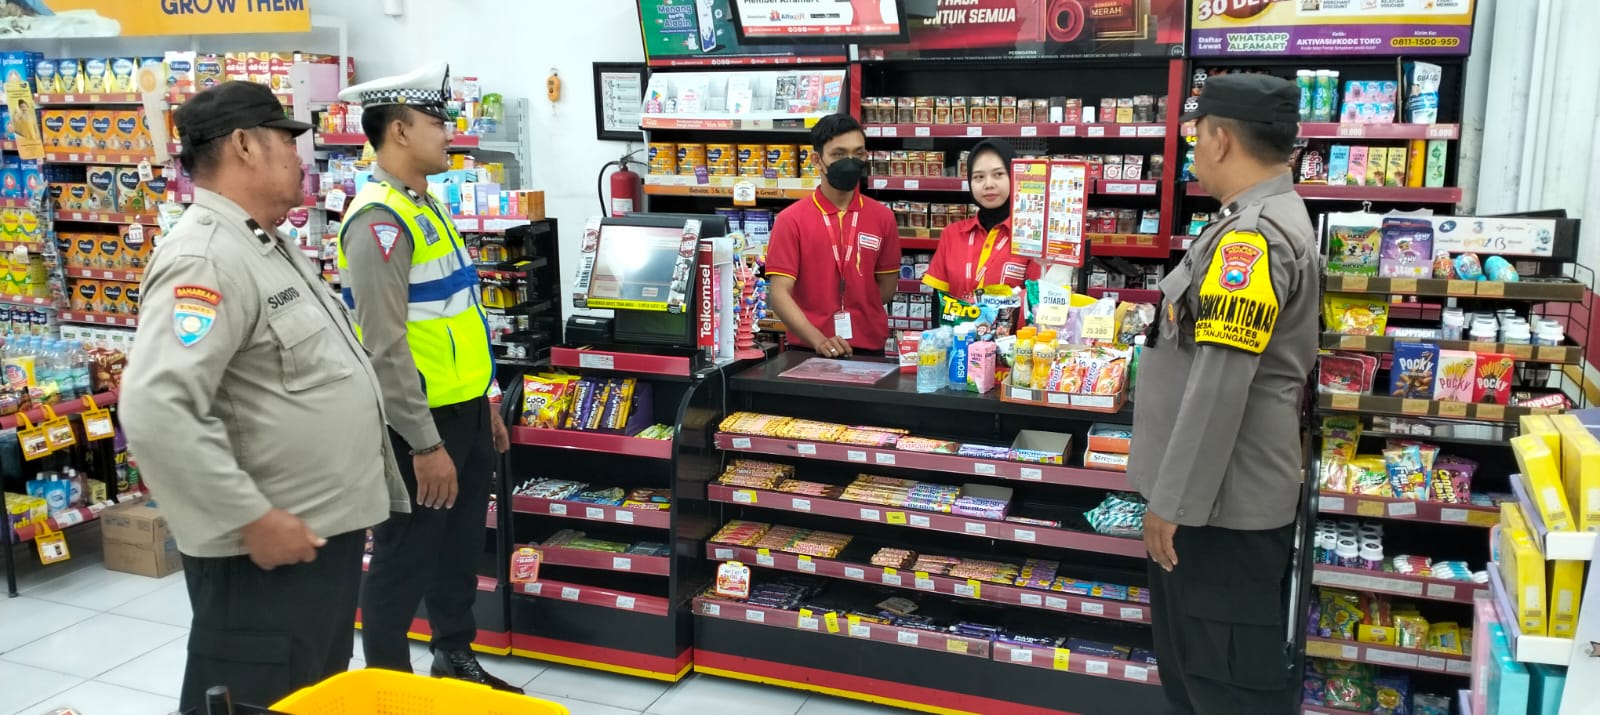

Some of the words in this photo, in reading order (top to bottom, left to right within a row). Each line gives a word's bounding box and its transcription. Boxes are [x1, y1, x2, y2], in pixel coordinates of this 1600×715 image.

[161, 0, 236, 14] GROW
[248, 0, 304, 12] THEM
[658, 5, 692, 13] Menang
[1092, 7, 1121, 16] MERAH
[969, 8, 1016, 23] SEMUA
[1229, 33, 1289, 42] WHATSAPP
[1393, 38, 1458, 46] 0811-1500-959
[1229, 42, 1286, 51] ALFAMART
[1305, 151, 1322, 178] Tango
[701, 264, 711, 338] Telkomsel
[943, 295, 980, 318] Taro
[984, 297, 1017, 306] INDOMILK
[1223, 324, 1258, 338] WATES
[1396, 329, 1435, 337] HAPPYDENT
[958, 348, 967, 378] ISOPLUS
[1399, 358, 1434, 372] POCKY
[1440, 377, 1471, 391] POCKY
[1476, 377, 1508, 391] POCKY
[1519, 394, 1562, 407] KOPIKO
